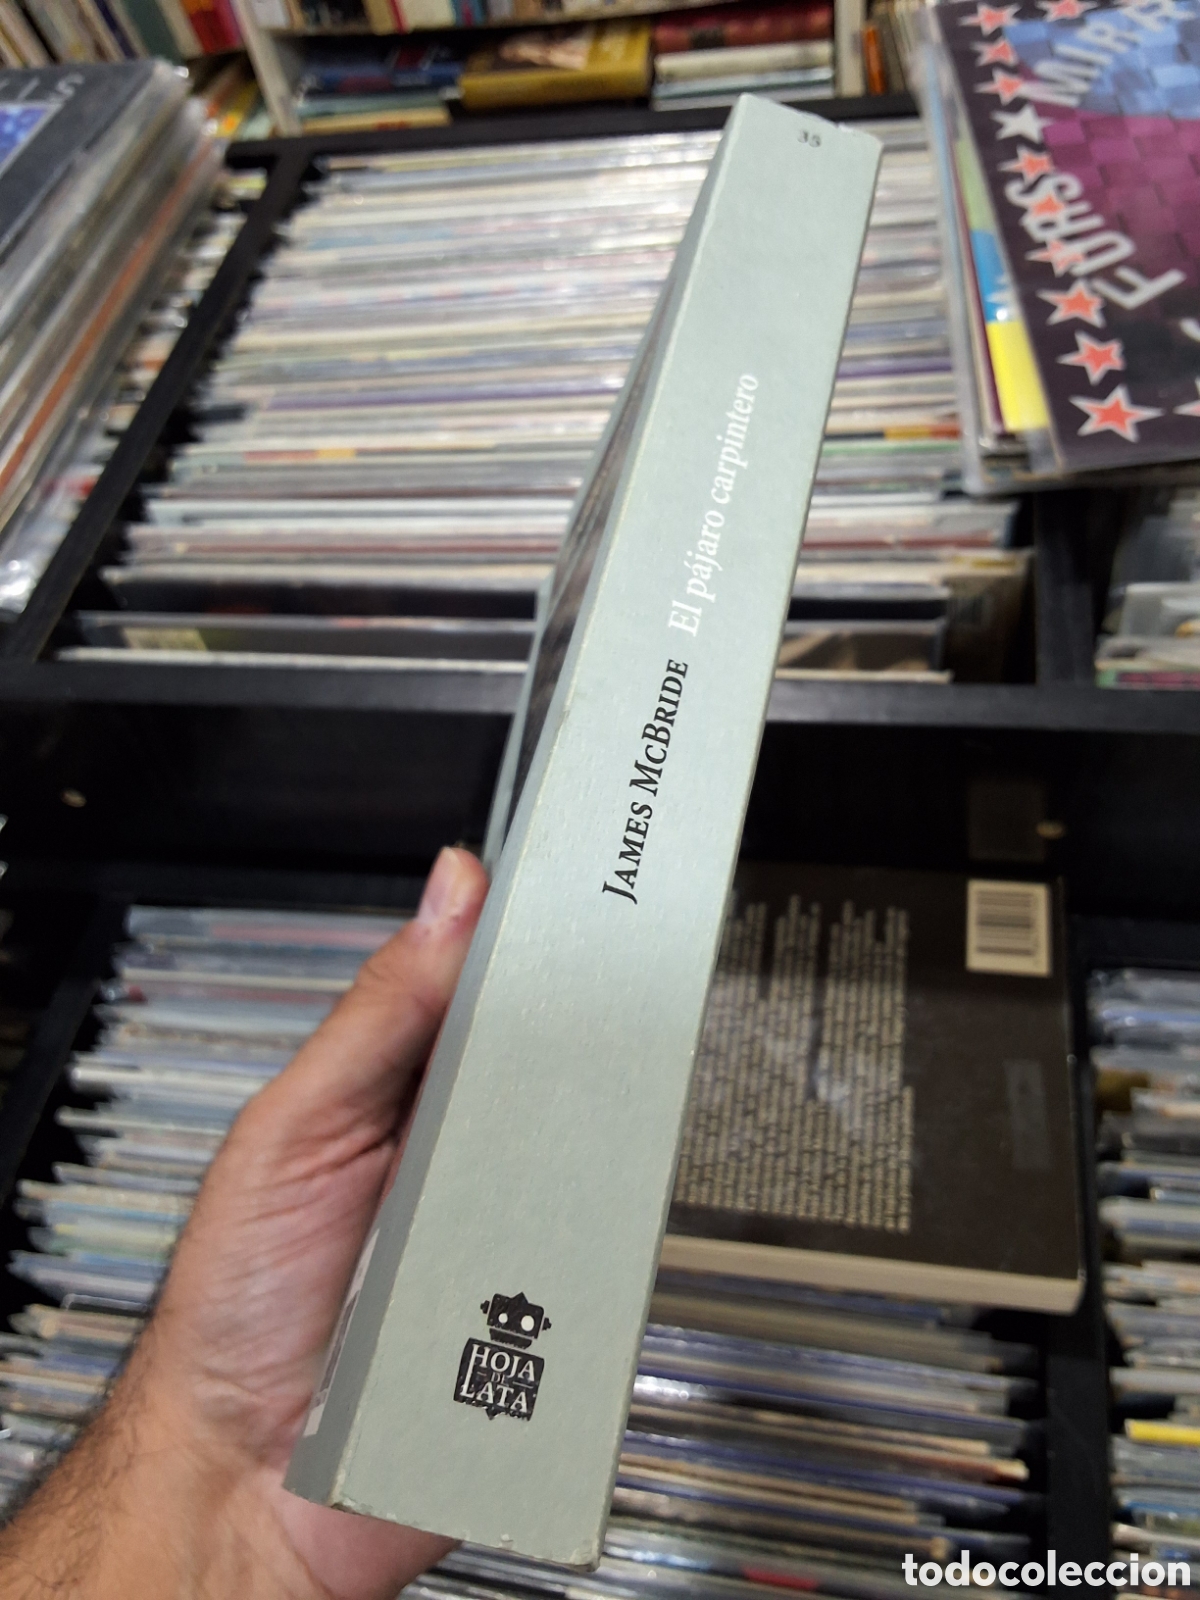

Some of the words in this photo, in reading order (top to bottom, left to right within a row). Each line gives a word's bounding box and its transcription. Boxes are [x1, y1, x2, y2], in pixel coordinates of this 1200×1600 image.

[1004, 166, 1187, 310] FURS
[710, 374, 759, 505] carpintero
[683, 509, 725, 604] pájaro
[668, 600, 702, 637] El
[601, 801, 653, 905] JAMES
[459, 1373, 528, 1413] LATA
[471, 1343, 535, 1382] HOJA
